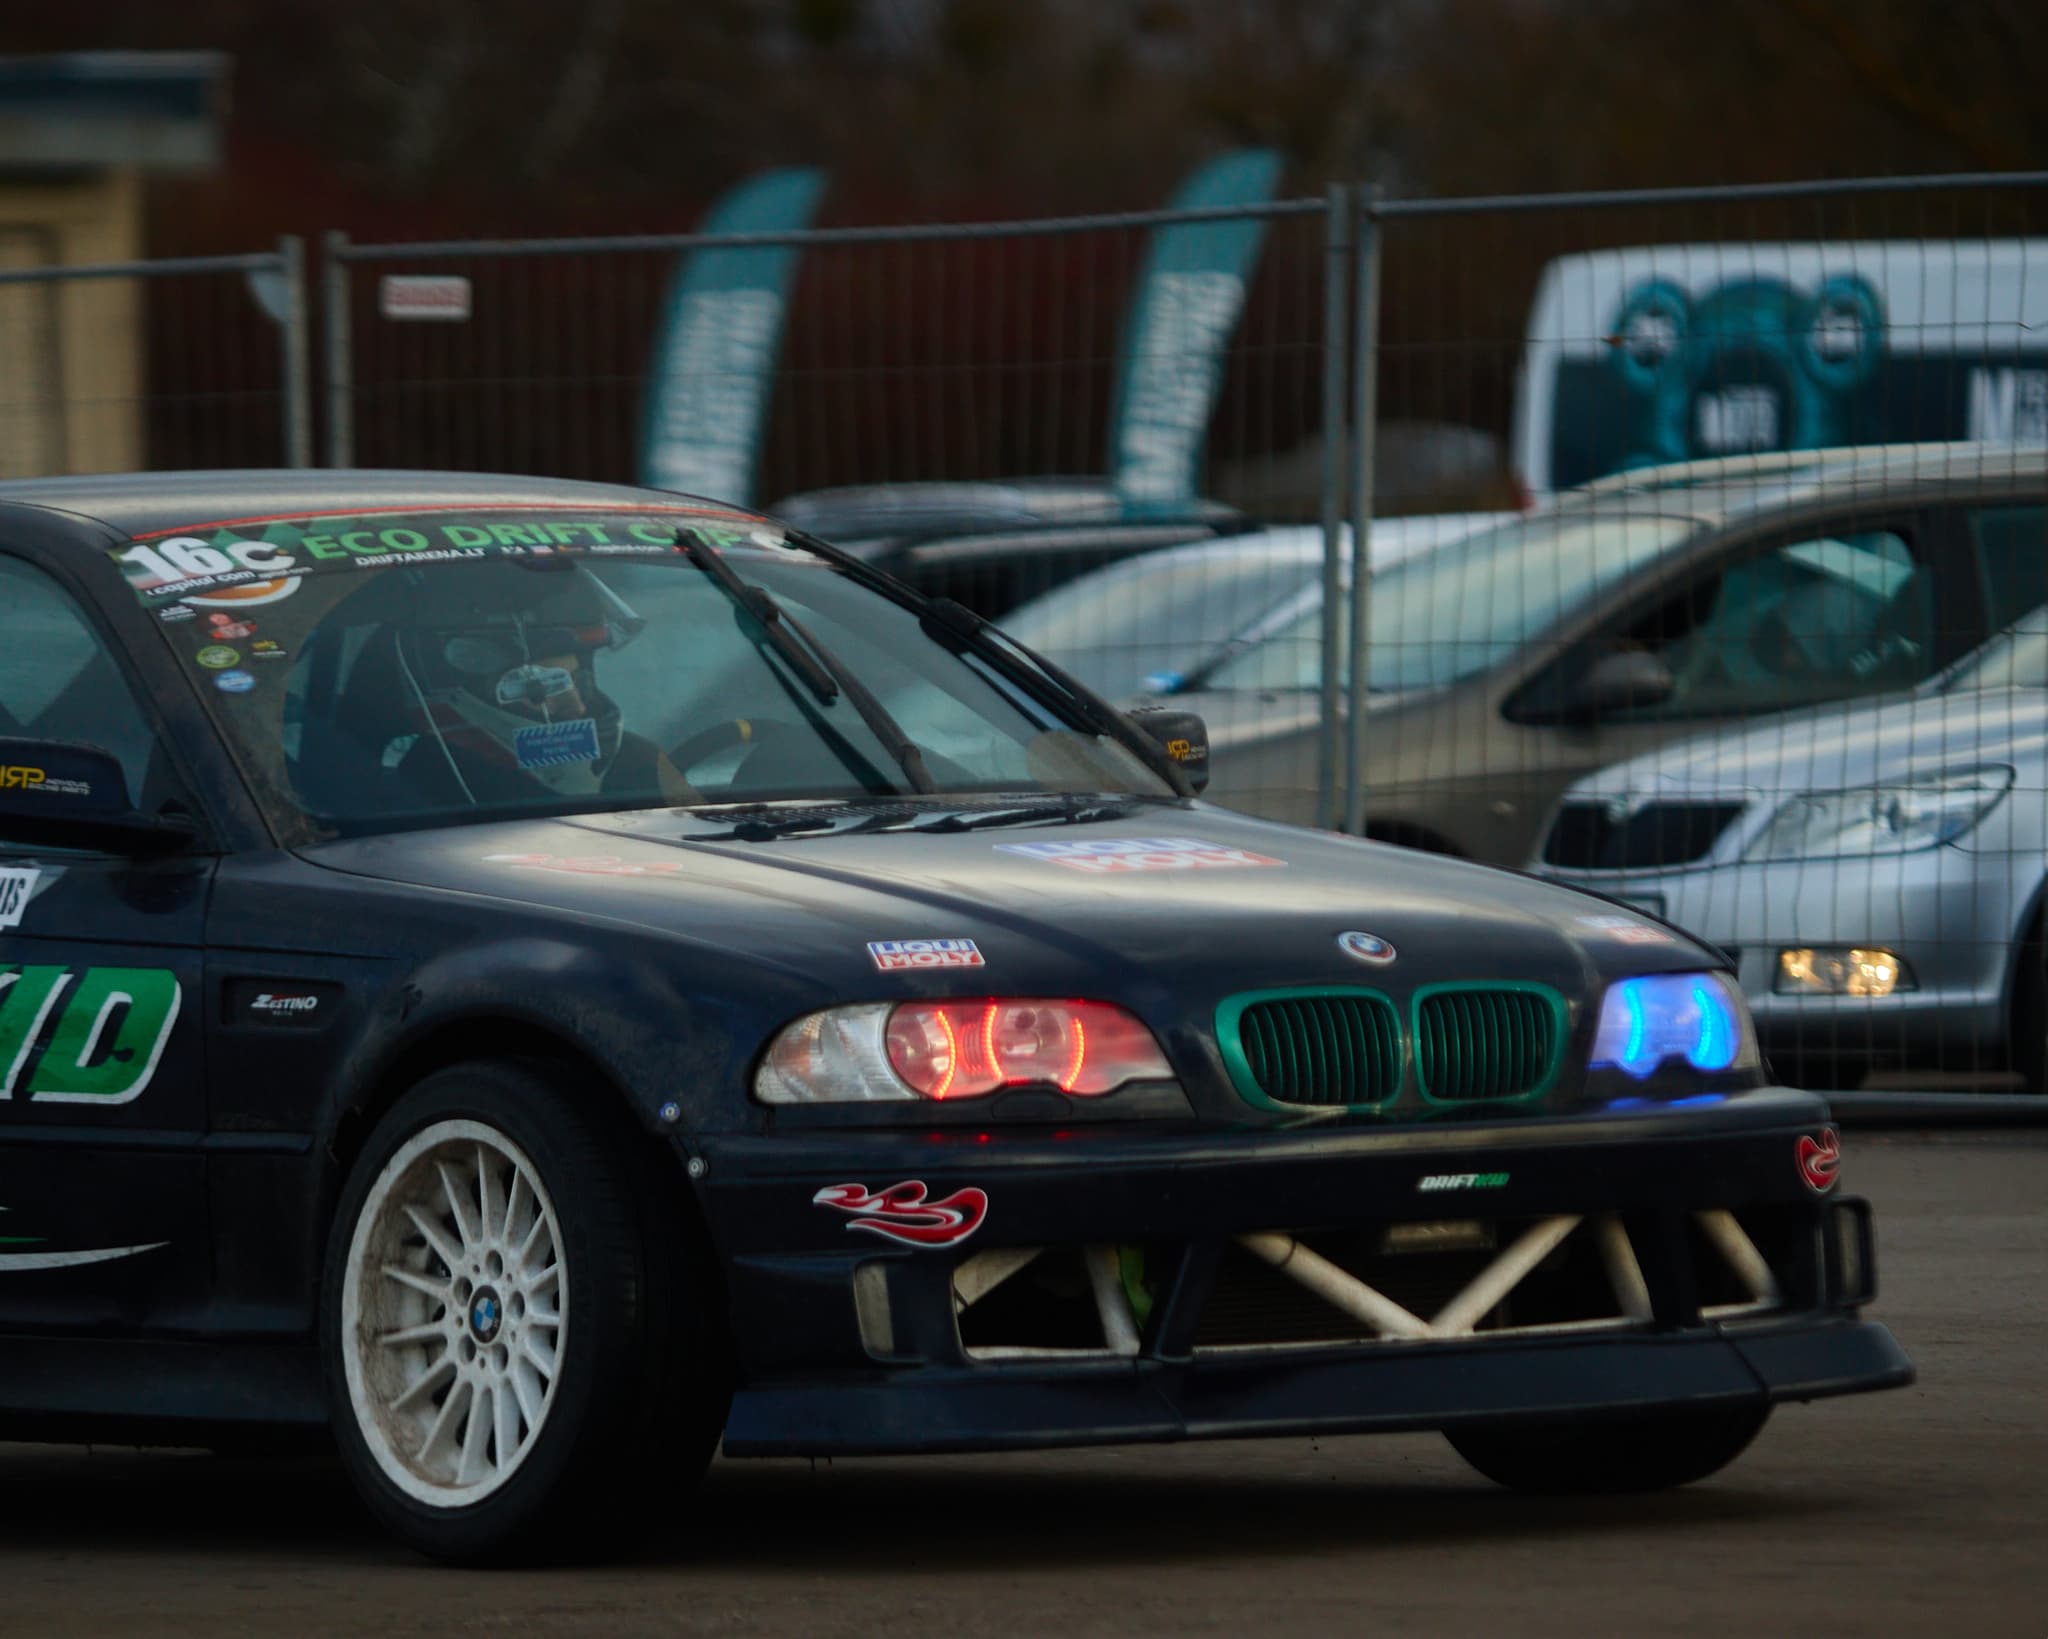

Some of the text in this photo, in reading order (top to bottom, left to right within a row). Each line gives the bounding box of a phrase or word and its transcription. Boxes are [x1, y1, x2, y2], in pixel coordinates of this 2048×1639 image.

[302, 521, 743, 560] ECO DRIFT CP
[354, 546, 486, 567] DRIFTARENA.LT
[877, 938, 974, 954] LIQUI
[882, 951, 975, 968] MOLY
